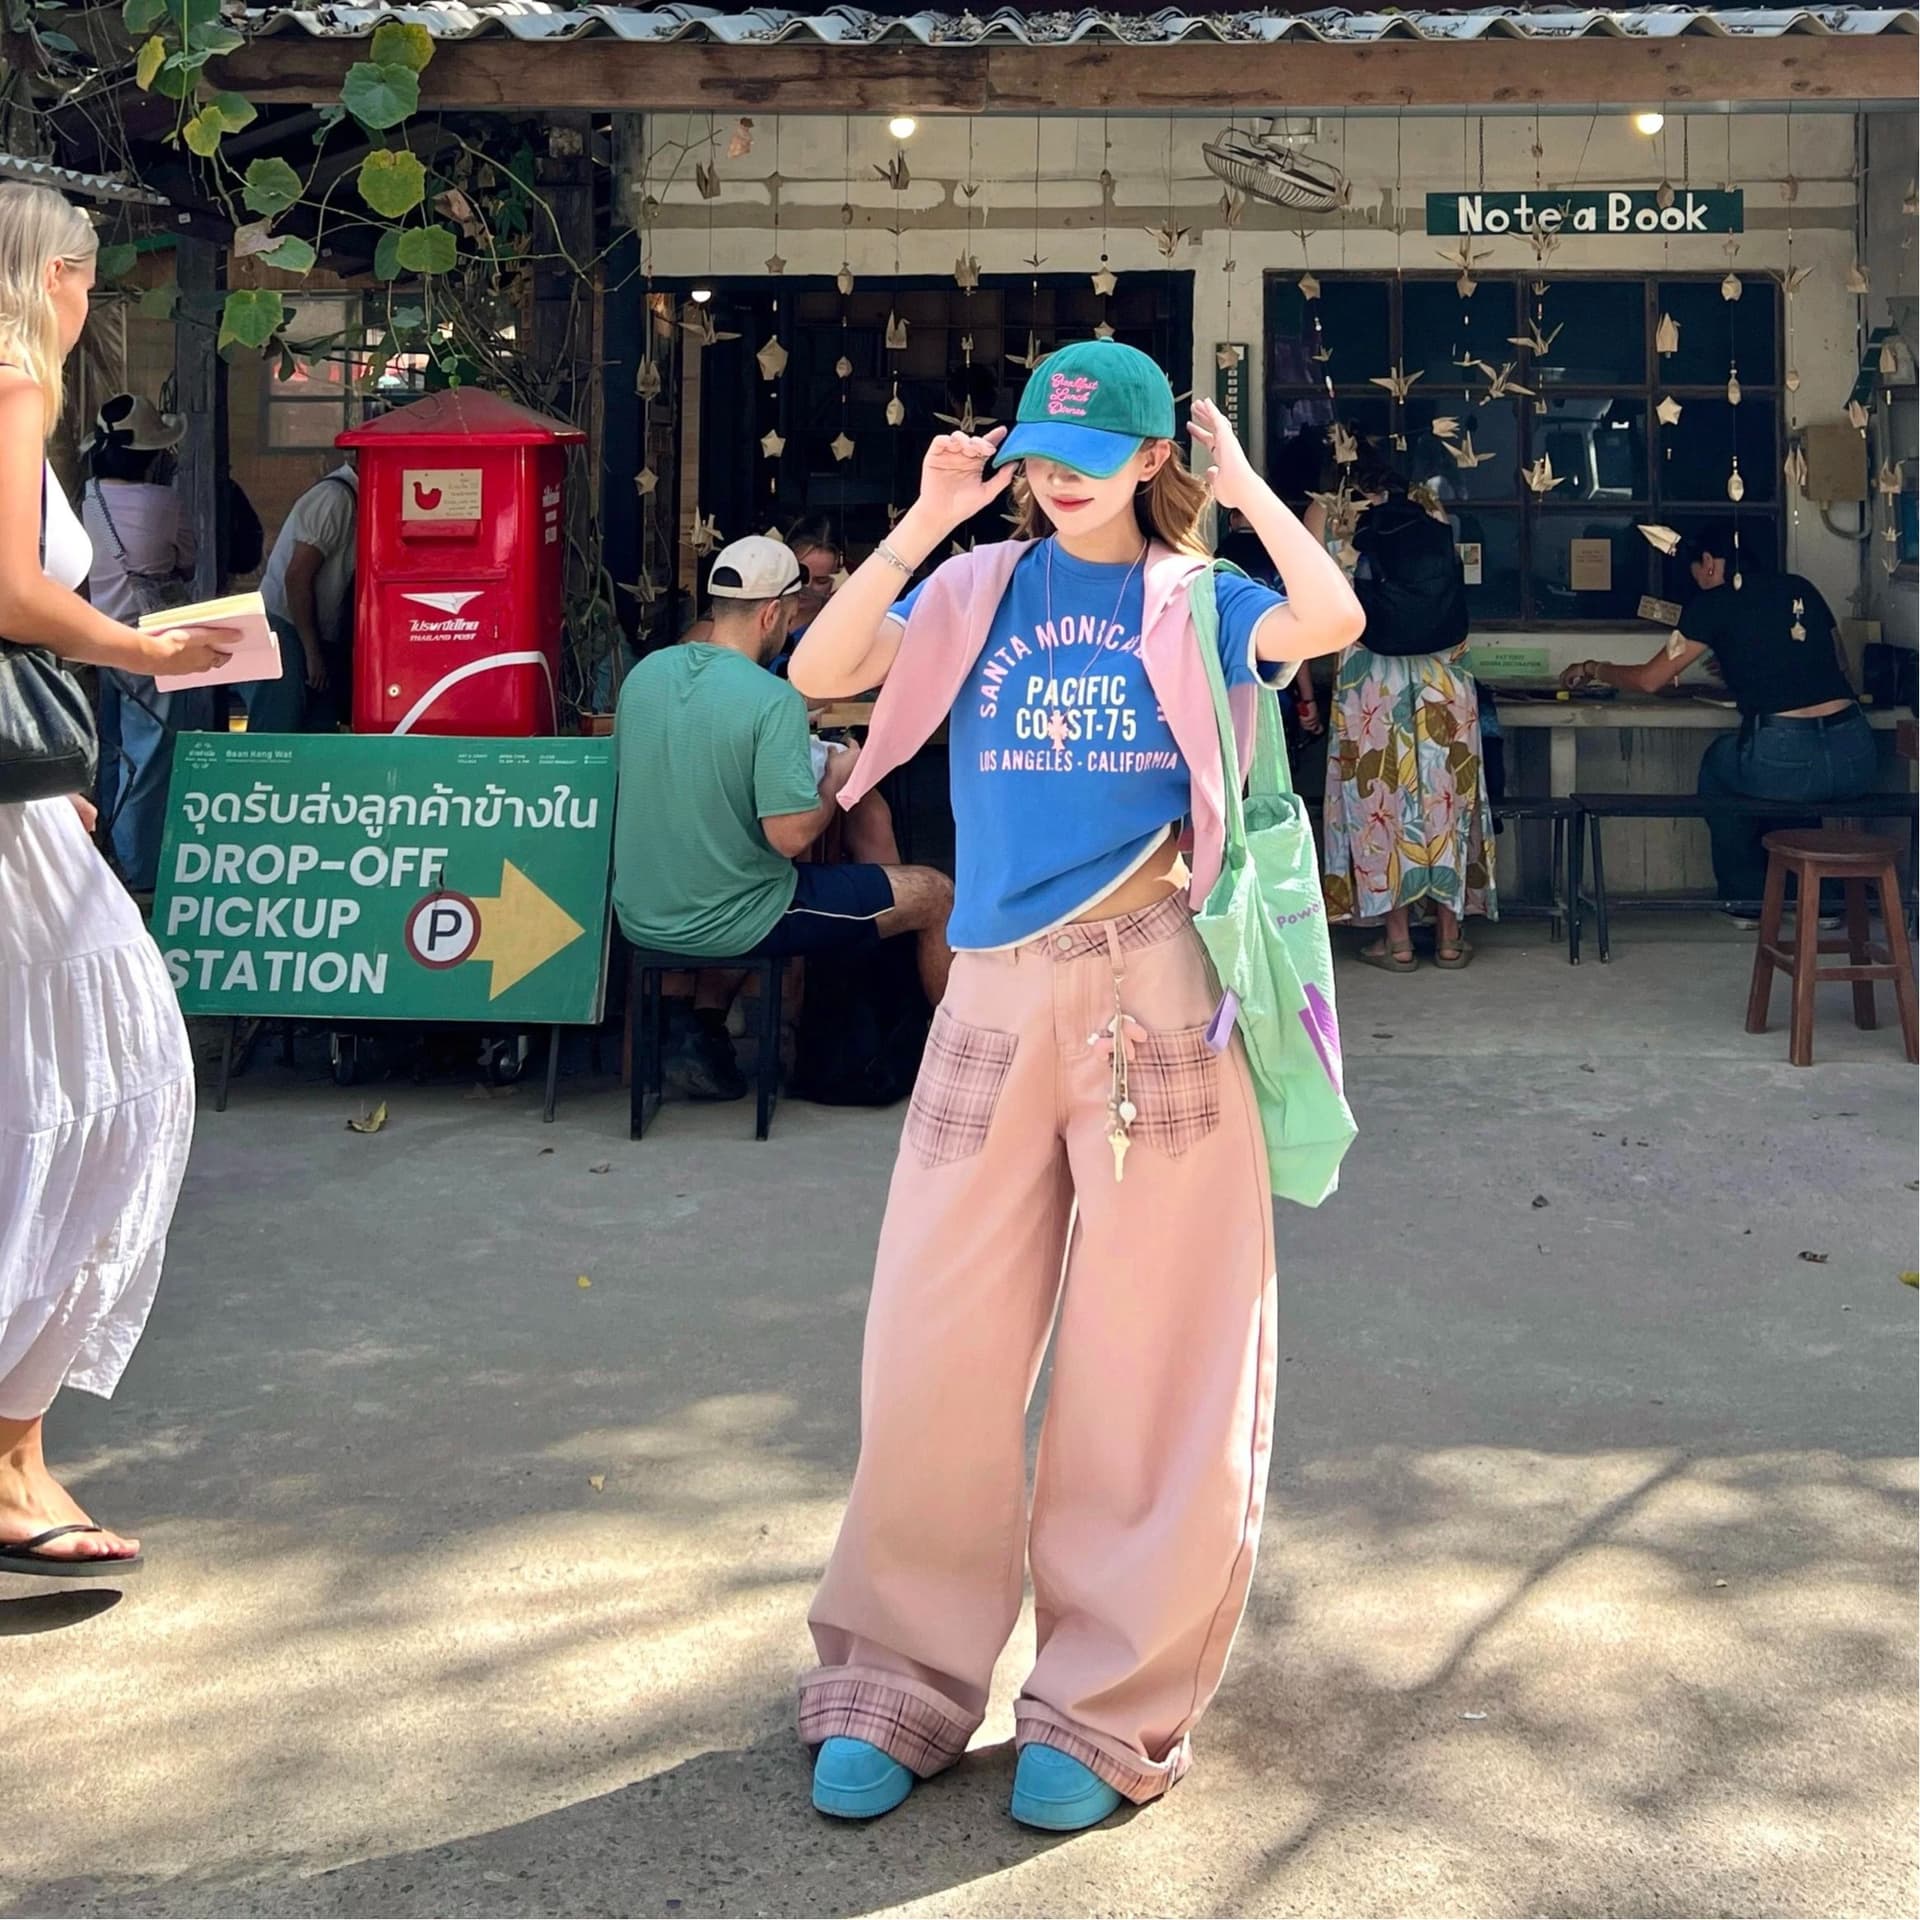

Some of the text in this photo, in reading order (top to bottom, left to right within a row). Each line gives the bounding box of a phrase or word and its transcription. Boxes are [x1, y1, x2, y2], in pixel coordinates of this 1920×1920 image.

[1457, 192, 1709, 233] Note a Book
[409, 632, 477, 642] THAILAND POST
[979, 634, 1033, 720] SANTA
[1026, 675, 1127, 706] PACIFIC
[1016, 707, 1137, 741] COST-75
[979, 749, 998, 772] LOS
[1001, 750, 1073, 772] ANGELES
[1087, 751, 1178, 773] CALIFORNIA
[182, 781, 599, 839] จุดรับส่งลูกค้าข้างใน
[174, 843, 449, 888] DROP-OFF
[166, 896, 361, 939] PICKUP
[426, 908, 462, 951] P
[163, 948, 389, 995] STATION
